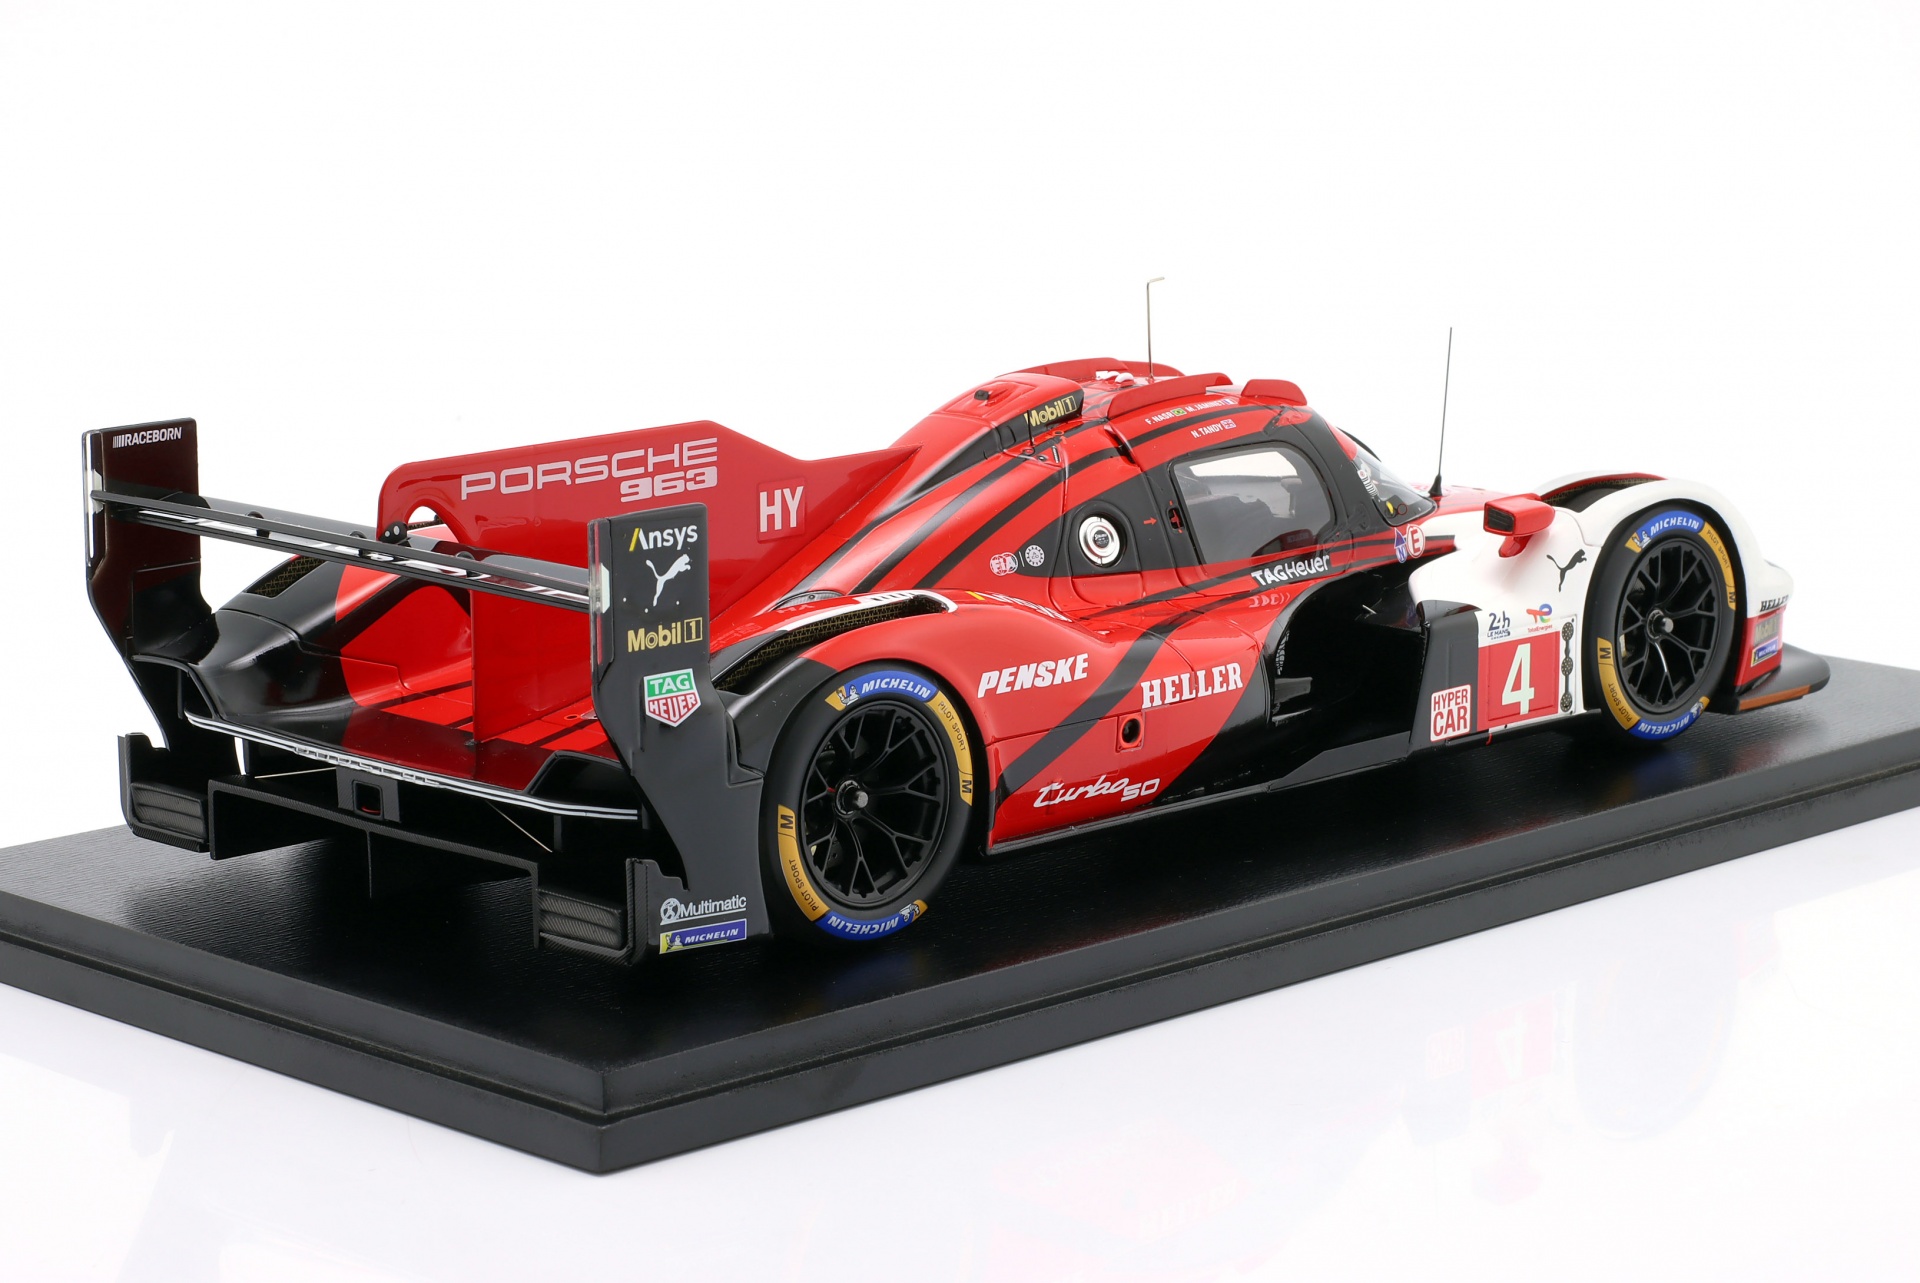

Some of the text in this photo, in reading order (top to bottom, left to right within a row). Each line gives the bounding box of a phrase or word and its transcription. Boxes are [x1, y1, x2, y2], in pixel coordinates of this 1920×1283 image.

[1025, 401, 1064, 427] Mobil
[124, 427, 182, 447] RACEBORN
[461, 437, 718, 500] PORSCHE
[620, 465, 718, 503] 963
[760, 486, 804, 532] HY
[629, 525, 698, 552] Ansys
[1650, 516, 1699, 537] MICHELIN
[1411, 529, 1421, 554] E
[1706, 529, 1730, 569] PILOT SPORT
[627, 622, 682, 652] Mobil
[1599, 647, 1611, 660] M
[650, 675, 690, 695] TAG
[861, 678, 931, 698] MICHELIN
[978, 653, 1089, 698] PENSKE
[1140, 662, 1243, 709] HELLER
[1502, 643, 1535, 715] 4
[649, 693, 696, 724] HEUER
[1433, 688, 1469, 712] HYPER
[1608, 683, 1632, 723] PILOT SPORT
[937, 701, 966, 752] PILOT SPORT
[1433, 705, 1468, 737] CAR
[1638, 714, 1690, 735] MICHELIN
[961, 779, 972, 794] M
[1033, 775, 1160, 808] turbo 50
[780, 814, 794, 830] M
[789, 859, 820, 912] PILOT SPORT
[680, 894, 747, 918] Multimatic
[684, 928, 739, 944] MICHELIN
[828, 915, 899, 936] MICHELIN
